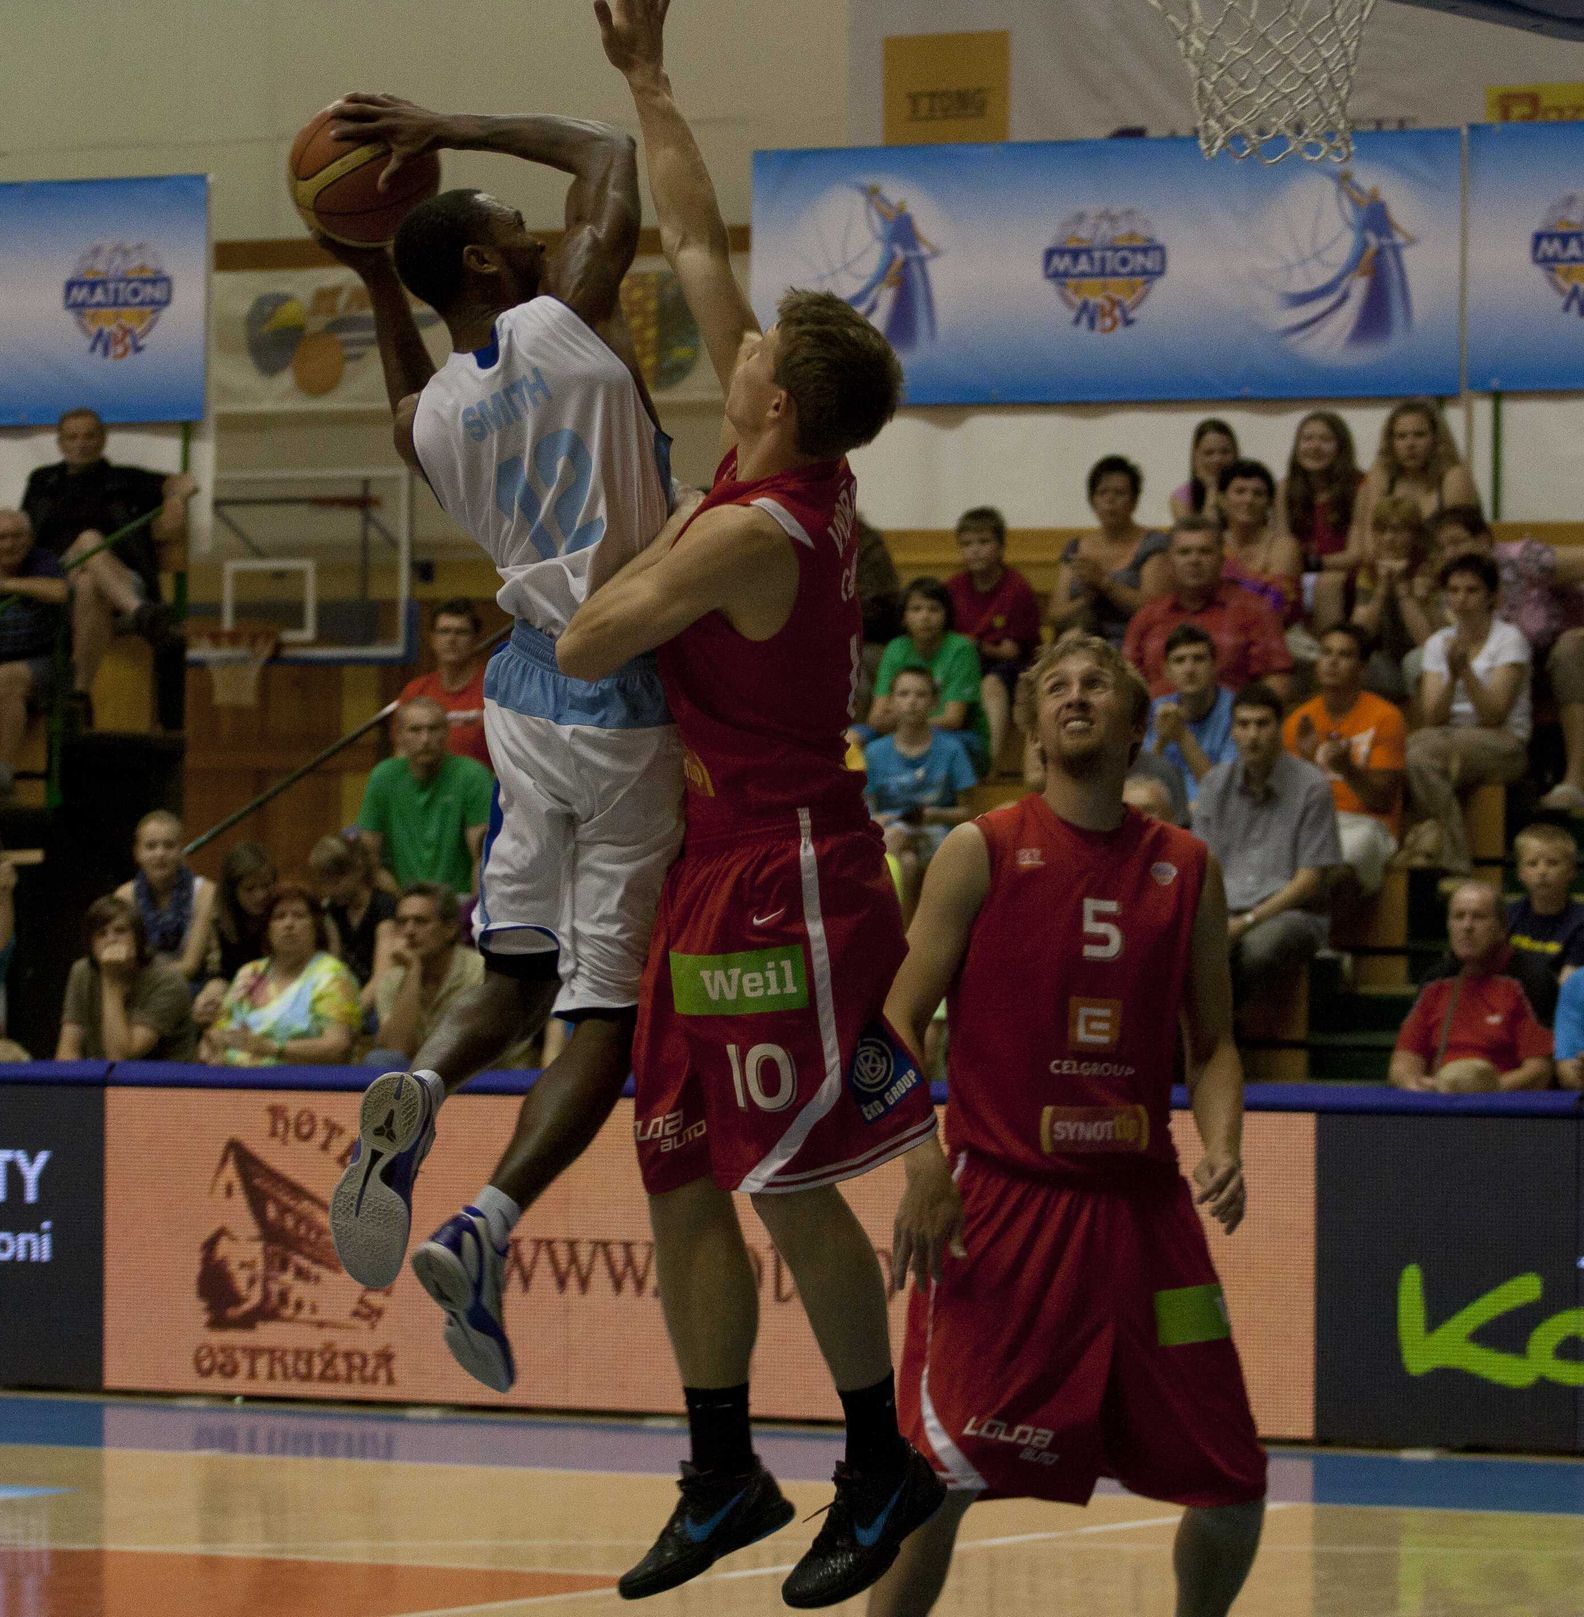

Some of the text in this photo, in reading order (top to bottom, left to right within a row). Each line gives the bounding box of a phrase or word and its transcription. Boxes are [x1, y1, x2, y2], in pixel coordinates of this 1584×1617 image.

[1046, 249, 1165, 277] MATTONI
[67, 279, 170, 306] MATTONI
[462, 367, 552, 441] SMITH
[496, 428, 607, 561] 12
[1082, 897, 1124, 962] 5
[700, 959, 798, 1001] Weil
[726, 1043, 798, 1112] 10
[884, 1068, 917, 1106] GROUP
